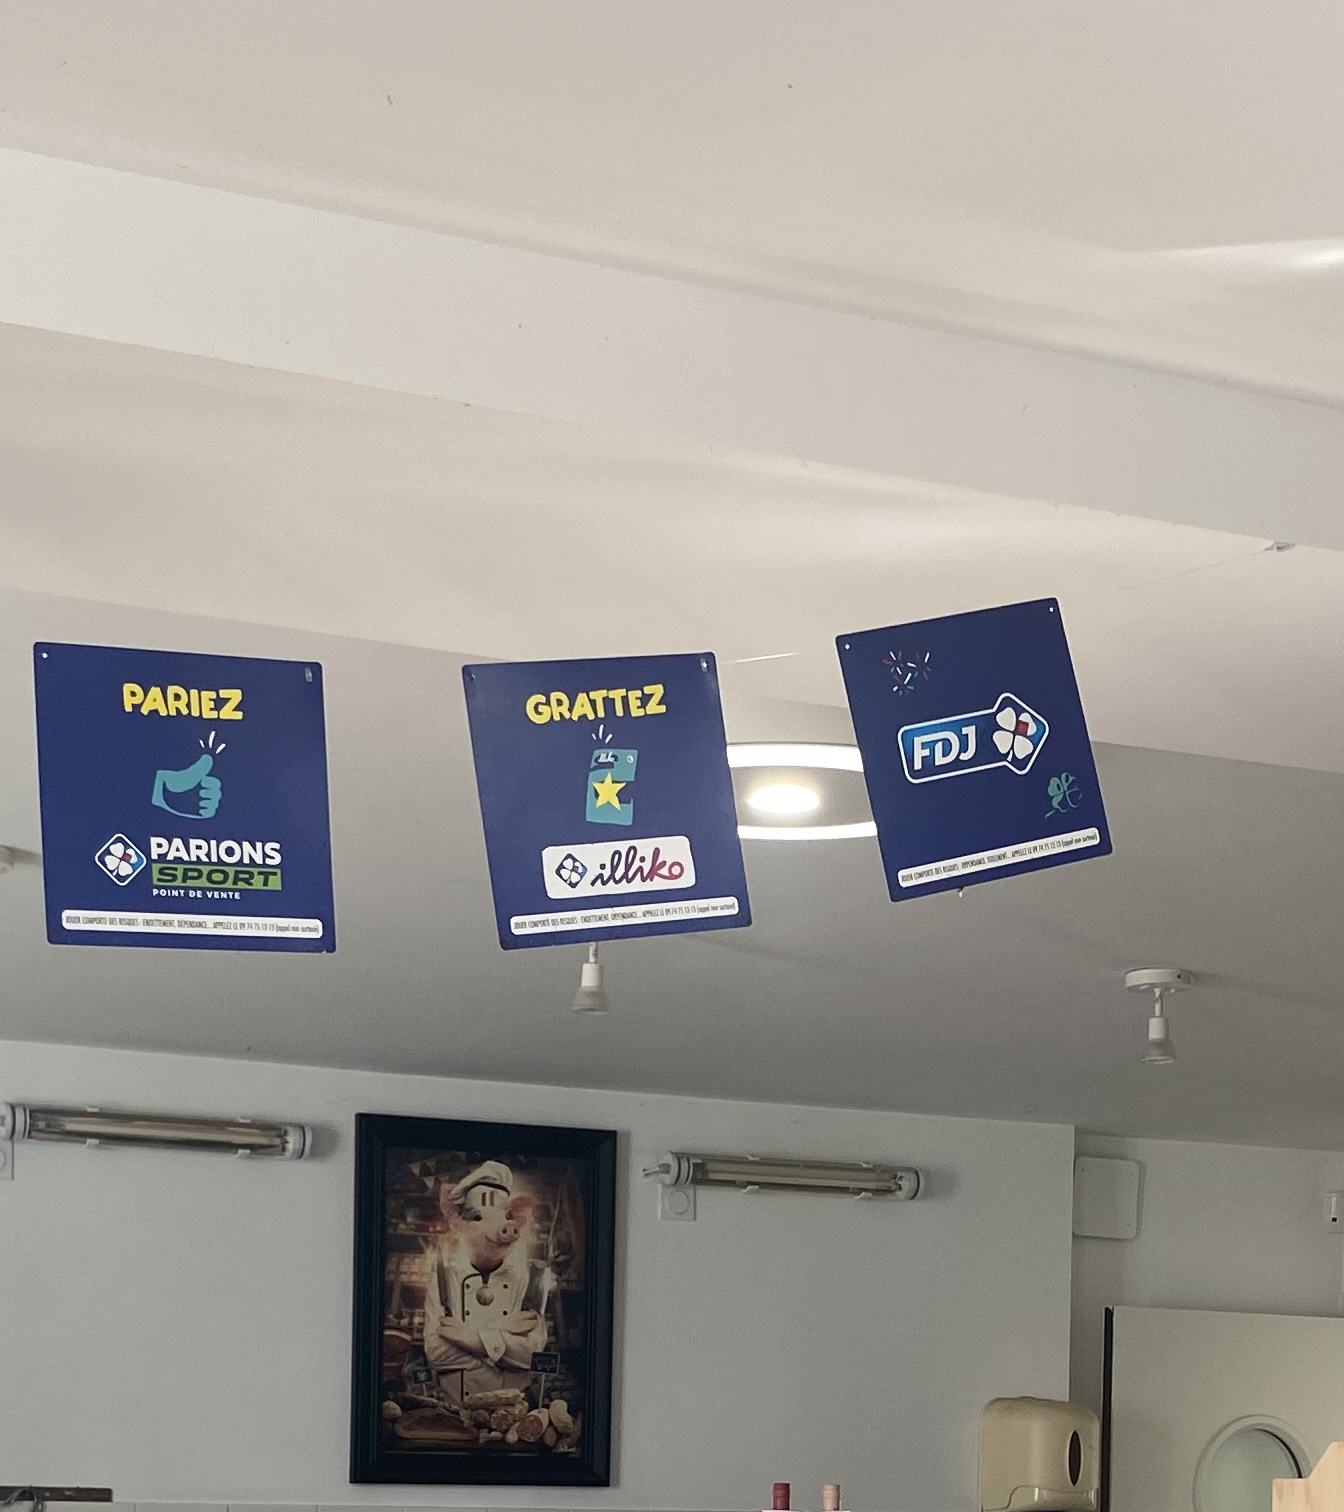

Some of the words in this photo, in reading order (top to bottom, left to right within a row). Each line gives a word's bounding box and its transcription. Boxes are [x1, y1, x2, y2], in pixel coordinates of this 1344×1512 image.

[123, 683, 243, 720] PARIEZ
[526, 684, 666, 724] GRATTEZ
[914, 725, 976, 770] FDJ
[150, 837, 282, 866] PARIONS
[590, 845, 684, 886] illiko
[153, 889, 185, 897] POINT
[189, 890, 202, 898] DE
[206, 891, 241, 899] VENTE
[156, 866, 278, 887] SPORT
